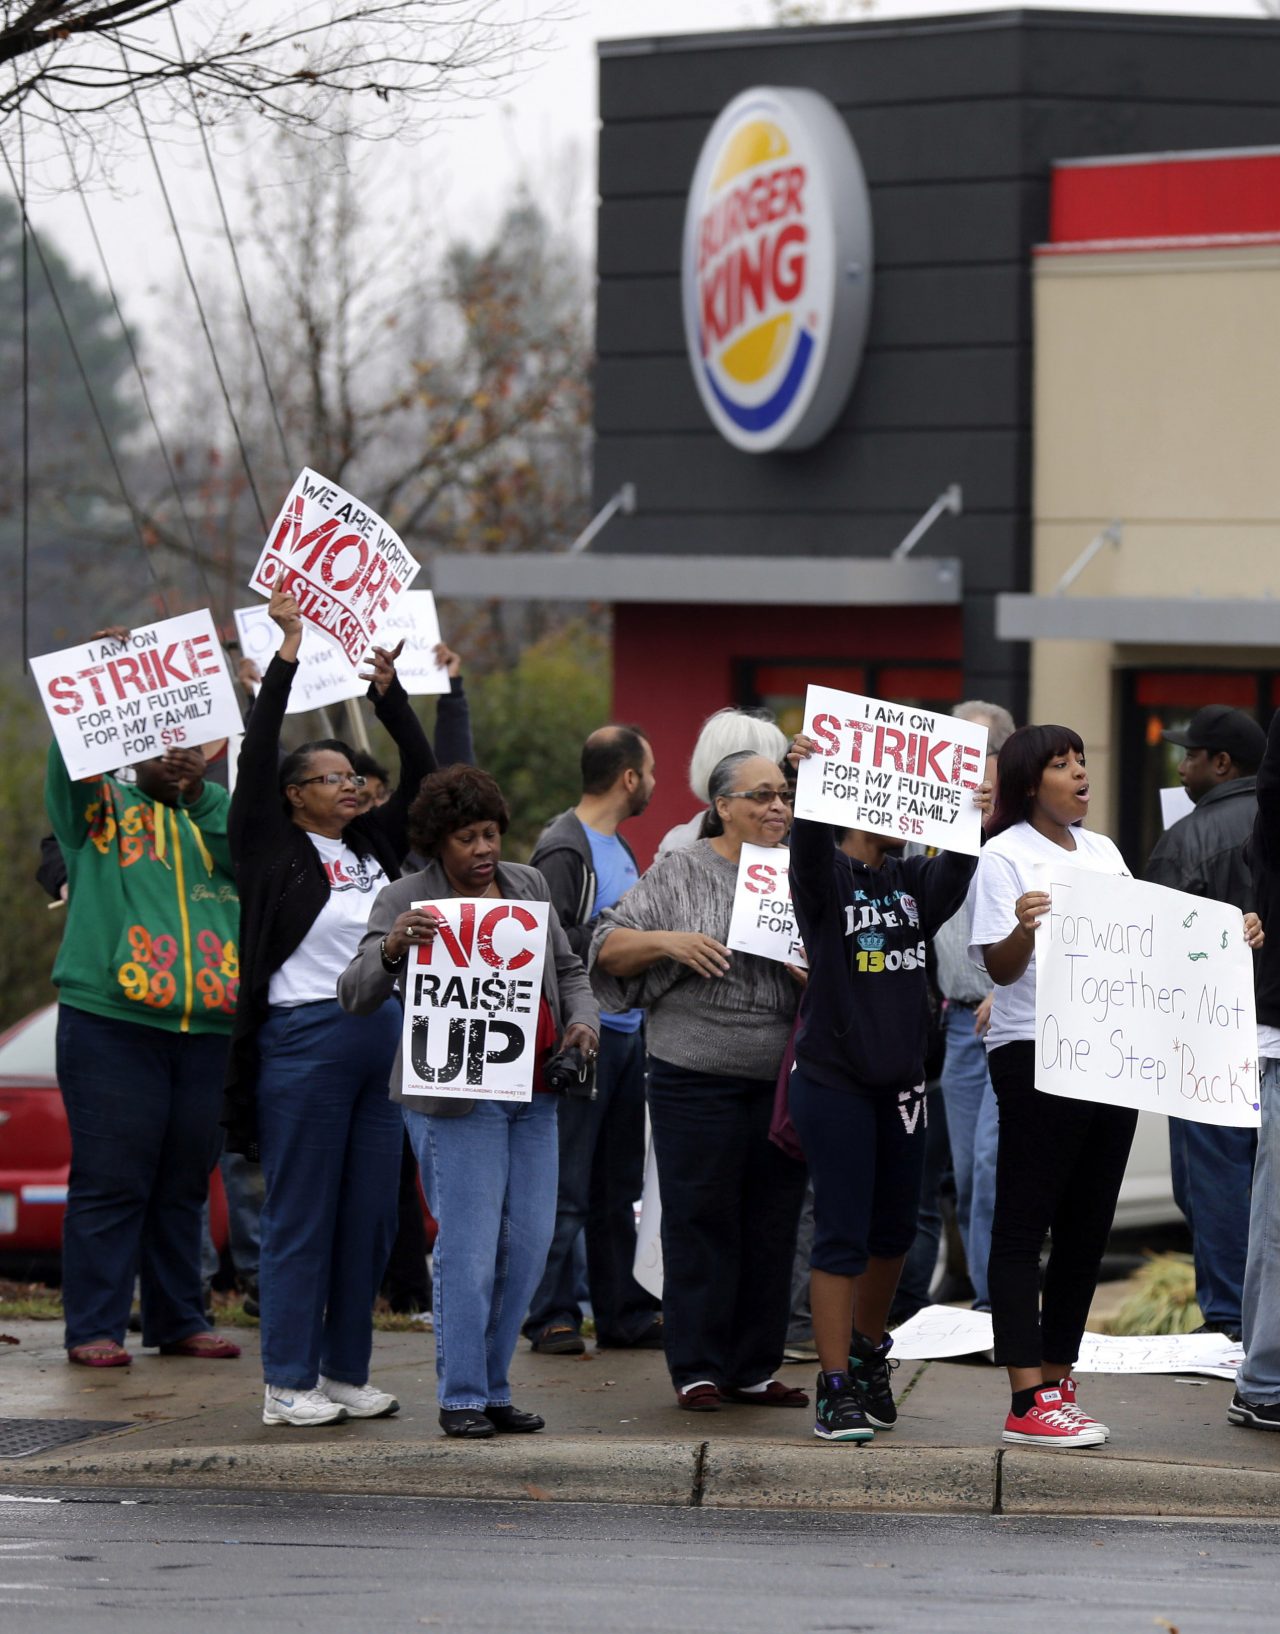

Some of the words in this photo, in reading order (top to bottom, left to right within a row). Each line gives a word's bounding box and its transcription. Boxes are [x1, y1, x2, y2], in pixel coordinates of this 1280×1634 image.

[697, 165, 807, 273] BURGER
[701, 223, 808, 359] KING
[302, 476, 338, 511] WE
[334, 502, 377, 539] ARE
[377, 528, 414, 583] WORTH
[272, 494, 402, 635] MORE
[291, 577, 357, 644] STRIKE
[48, 634, 221, 716] STRIKE
[87, 649, 96, 662] I
[100, 640, 129, 660] AM
[133, 630, 159, 648] ON
[76, 709, 113, 731] FOR
[116, 700, 141, 720] MY
[147, 681, 211, 711] FUTURE
[83, 727, 120, 748] FOR
[123, 717, 148, 738] MY
[153, 699, 213, 728] FAMILY
[864, 703, 870, 718] I
[874, 706, 904, 726] AM
[909, 714, 936, 734] ON
[122, 735, 157, 757] FOR
[160, 726, 187, 746] $15
[811, 713, 982, 790] STRIKE
[821, 780, 859, 802] FOR
[864, 787, 893, 808] MY
[897, 795, 960, 826] FAMILY
[823, 761, 860, 783] FOR
[865, 768, 893, 790] MY
[898, 776, 962, 808] FUTURE
[856, 806, 894, 829] FOR
[898, 813, 925, 836] $15
[416, 903, 539, 971] NC
[756, 915, 794, 936] FOR
[1050, 883, 1154, 958] Forward
[1065, 953, 1187, 1023] Together,
[1197, 983, 1246, 1030] Not
[411, 1015, 526, 1086] UP
[1041, 1014, 1091, 1072] One
[1105, 1029, 1167, 1096] Step
